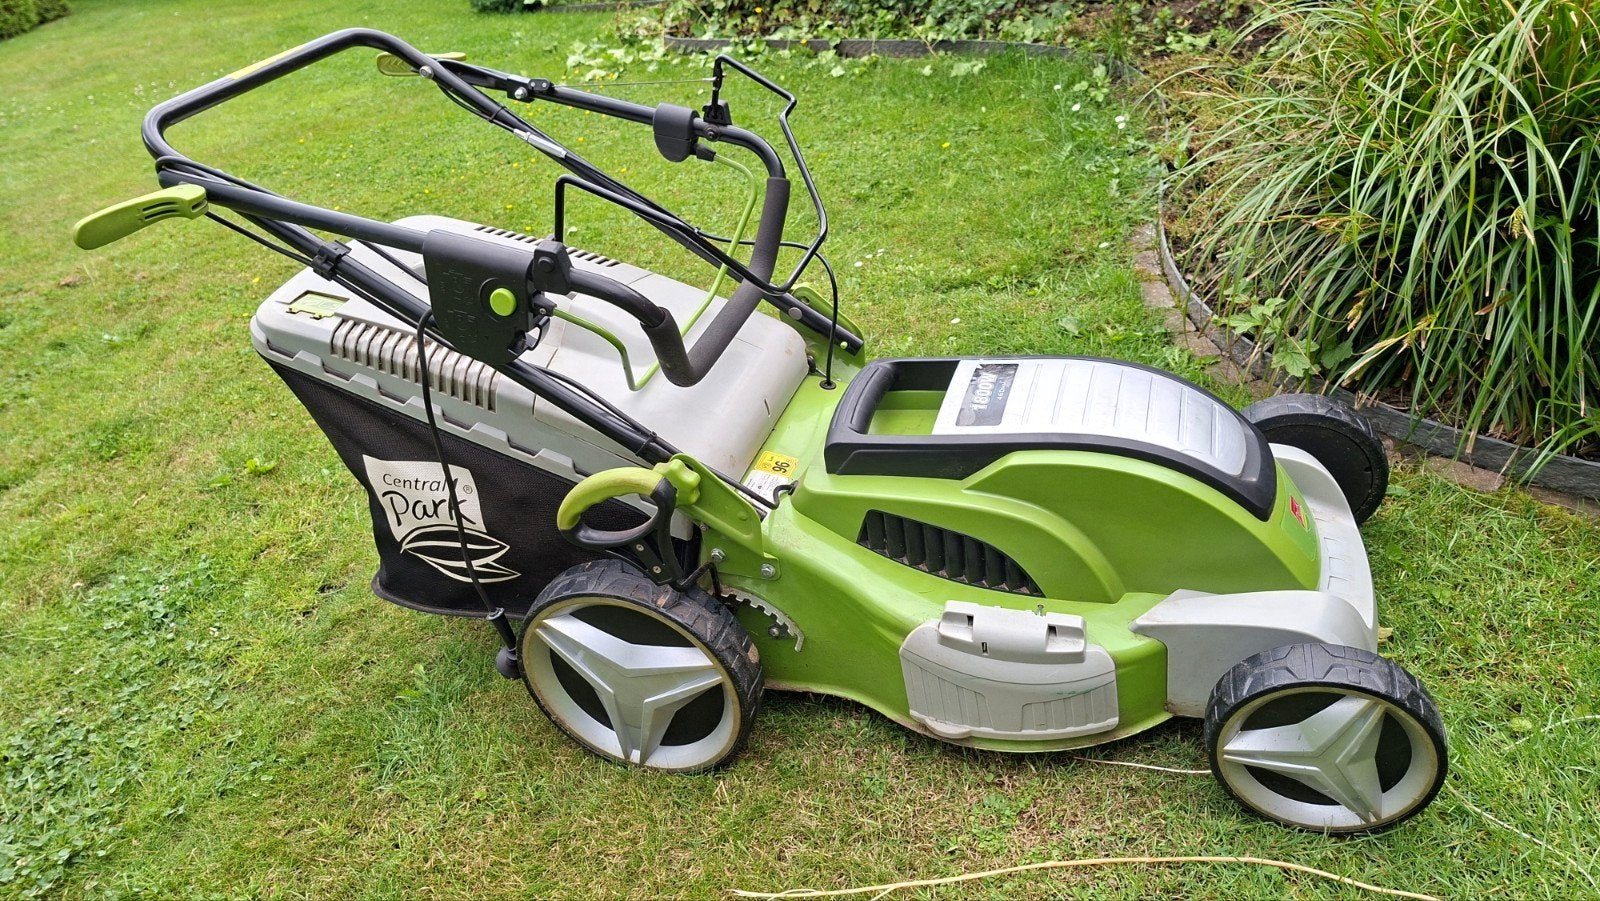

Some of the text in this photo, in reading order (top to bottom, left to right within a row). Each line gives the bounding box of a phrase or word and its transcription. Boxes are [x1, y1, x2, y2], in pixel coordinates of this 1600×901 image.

[970, 372, 998, 411] 1800W
[772, 460, 790, 474] 96
[382, 473, 448, 492] Central
[382, 478, 477, 526] Park
